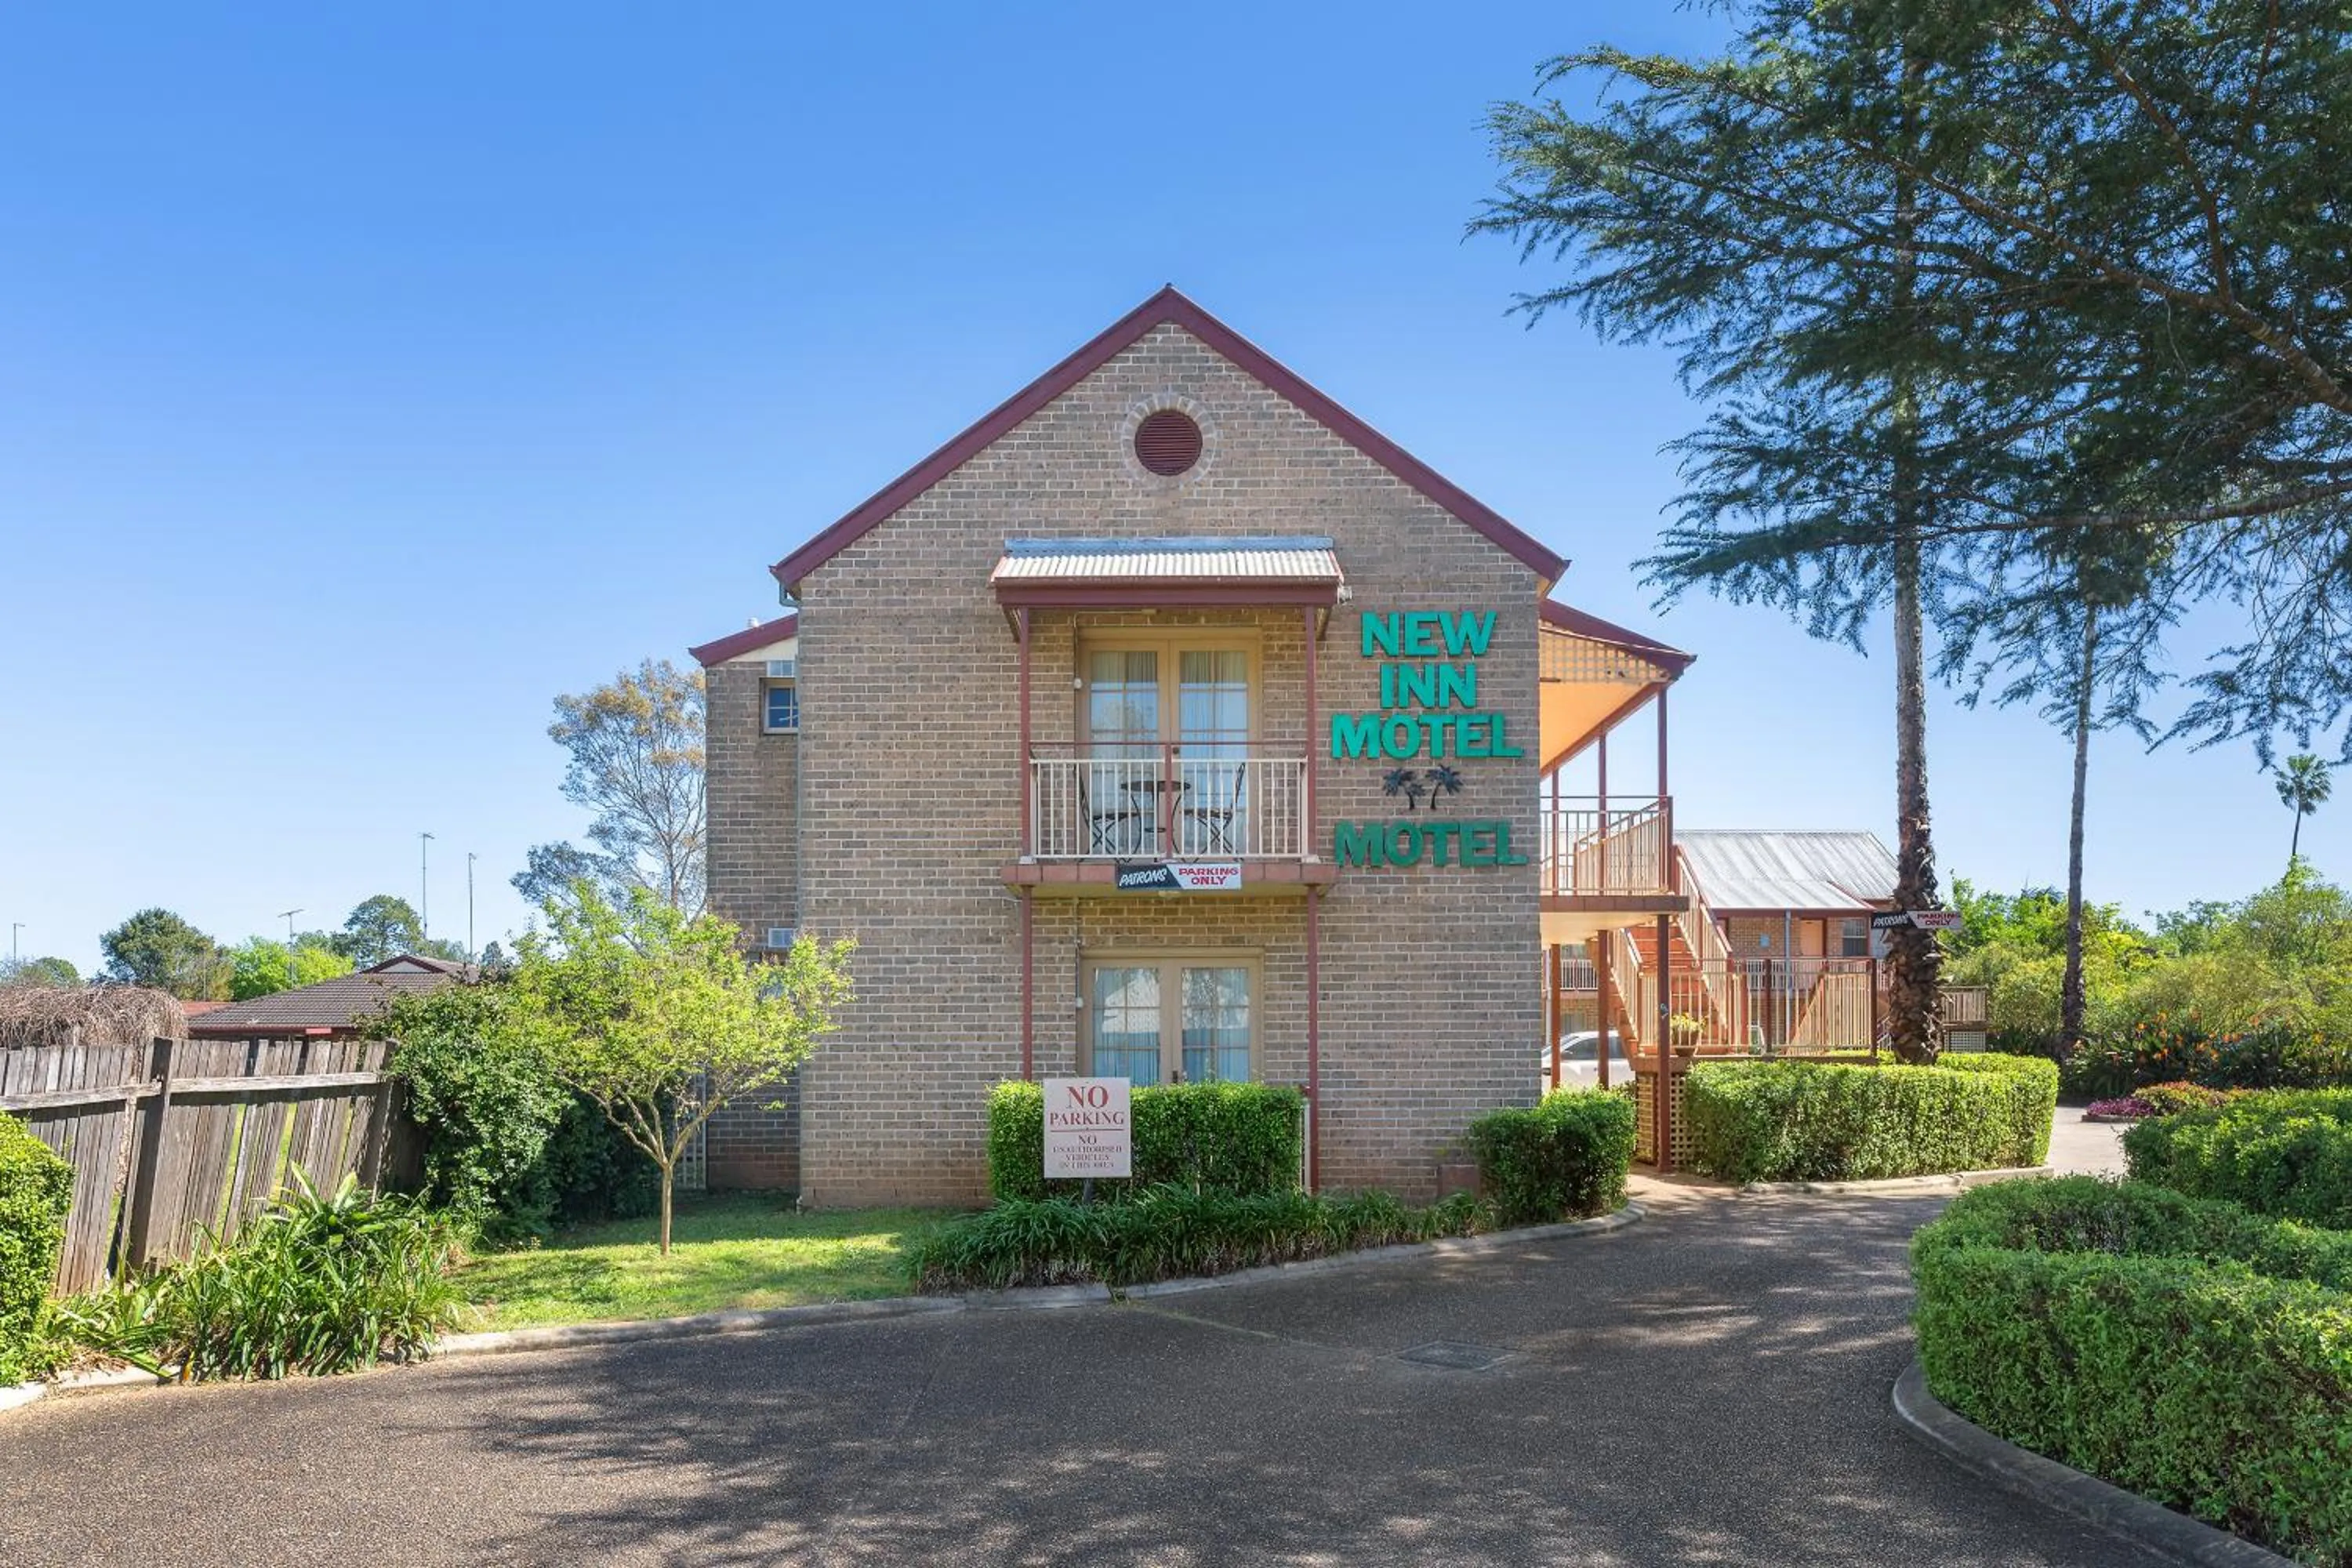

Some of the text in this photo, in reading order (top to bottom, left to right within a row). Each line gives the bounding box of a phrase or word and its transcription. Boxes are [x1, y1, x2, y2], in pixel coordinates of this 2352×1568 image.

[1360, 610, 1497, 657] NEW
[1380, 664, 1477, 709] INN
[1330, 713, 1525, 760] MOTEL
[1334, 822, 1528, 867] MOTEL
[1119, 868, 1167, 887] PATRONS
[1191, 877, 1227, 885] ONLY
[1066, 1085, 1109, 1109] NO
[1050, 1112, 1125, 1125] PARKING
[1078, 1134, 1098, 1145] NO
